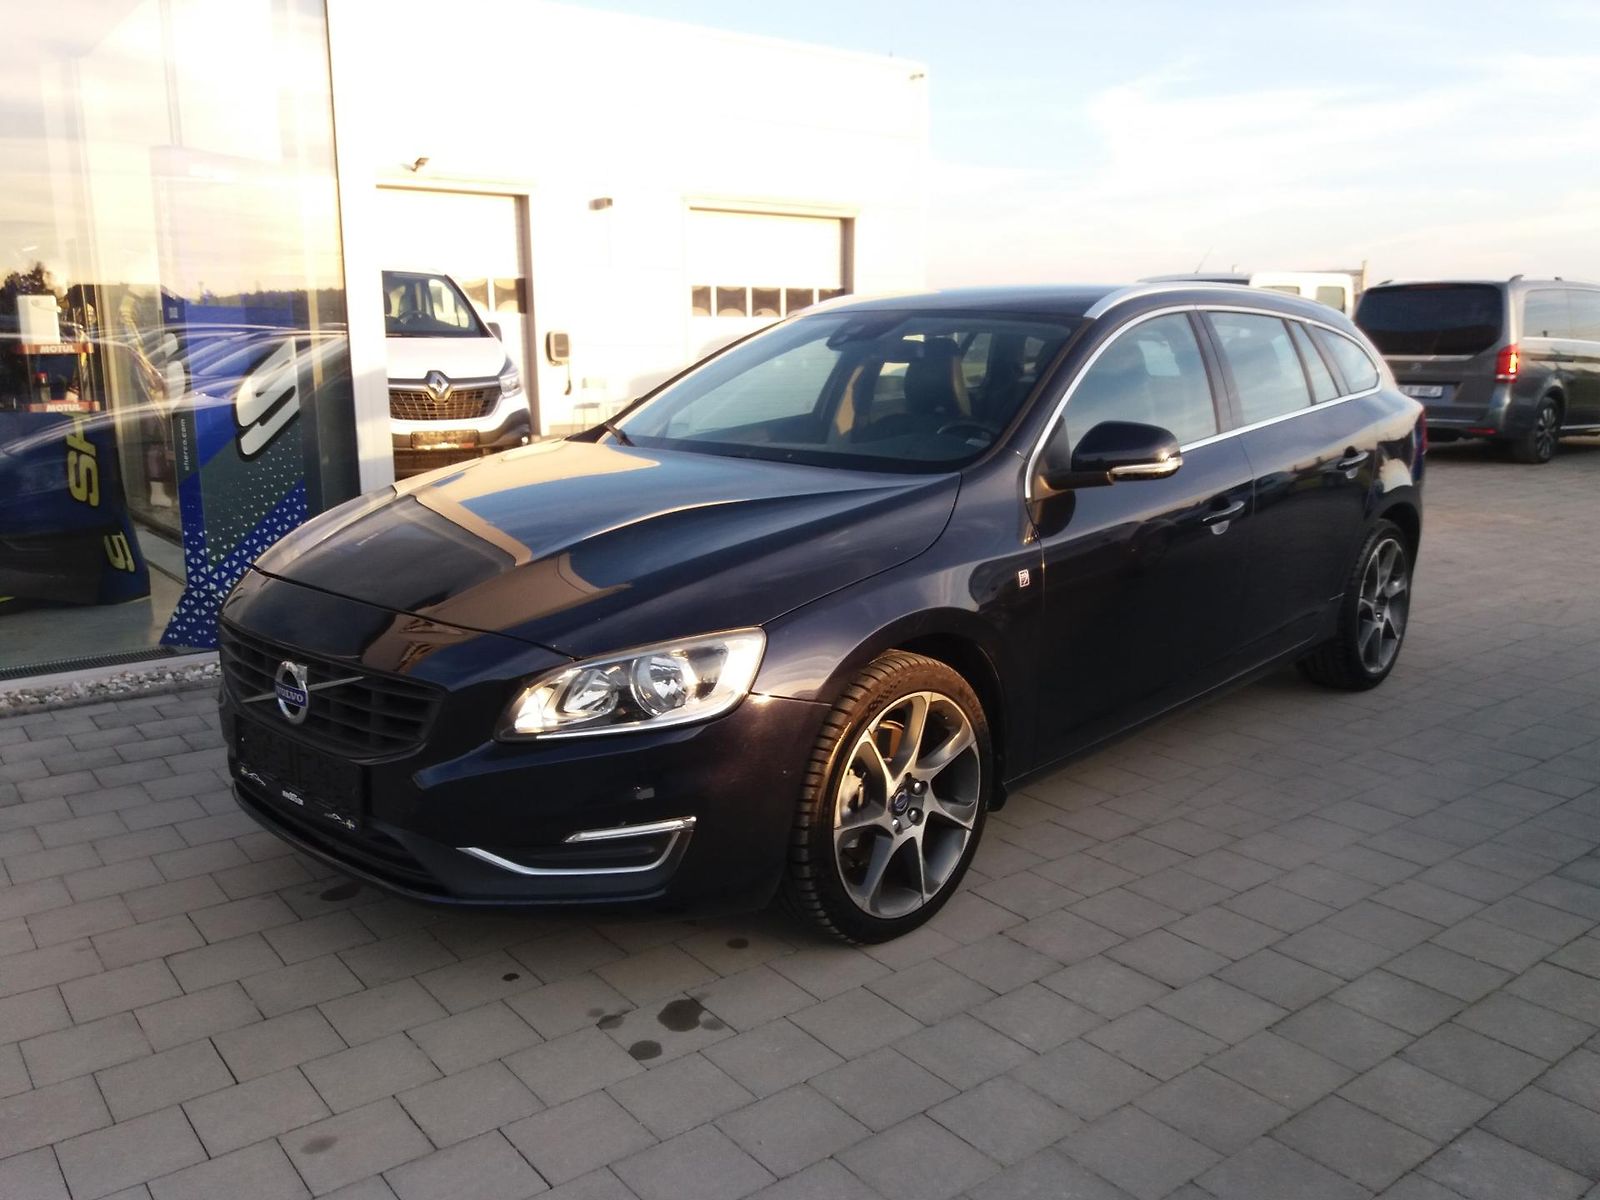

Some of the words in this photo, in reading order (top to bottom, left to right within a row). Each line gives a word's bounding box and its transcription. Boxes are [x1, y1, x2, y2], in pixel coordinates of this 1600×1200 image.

[40, 345, 75, 353] MOTUL
[46, 404, 81, 412] MOTUL
[277, 686, 304, 703] VOLVO
